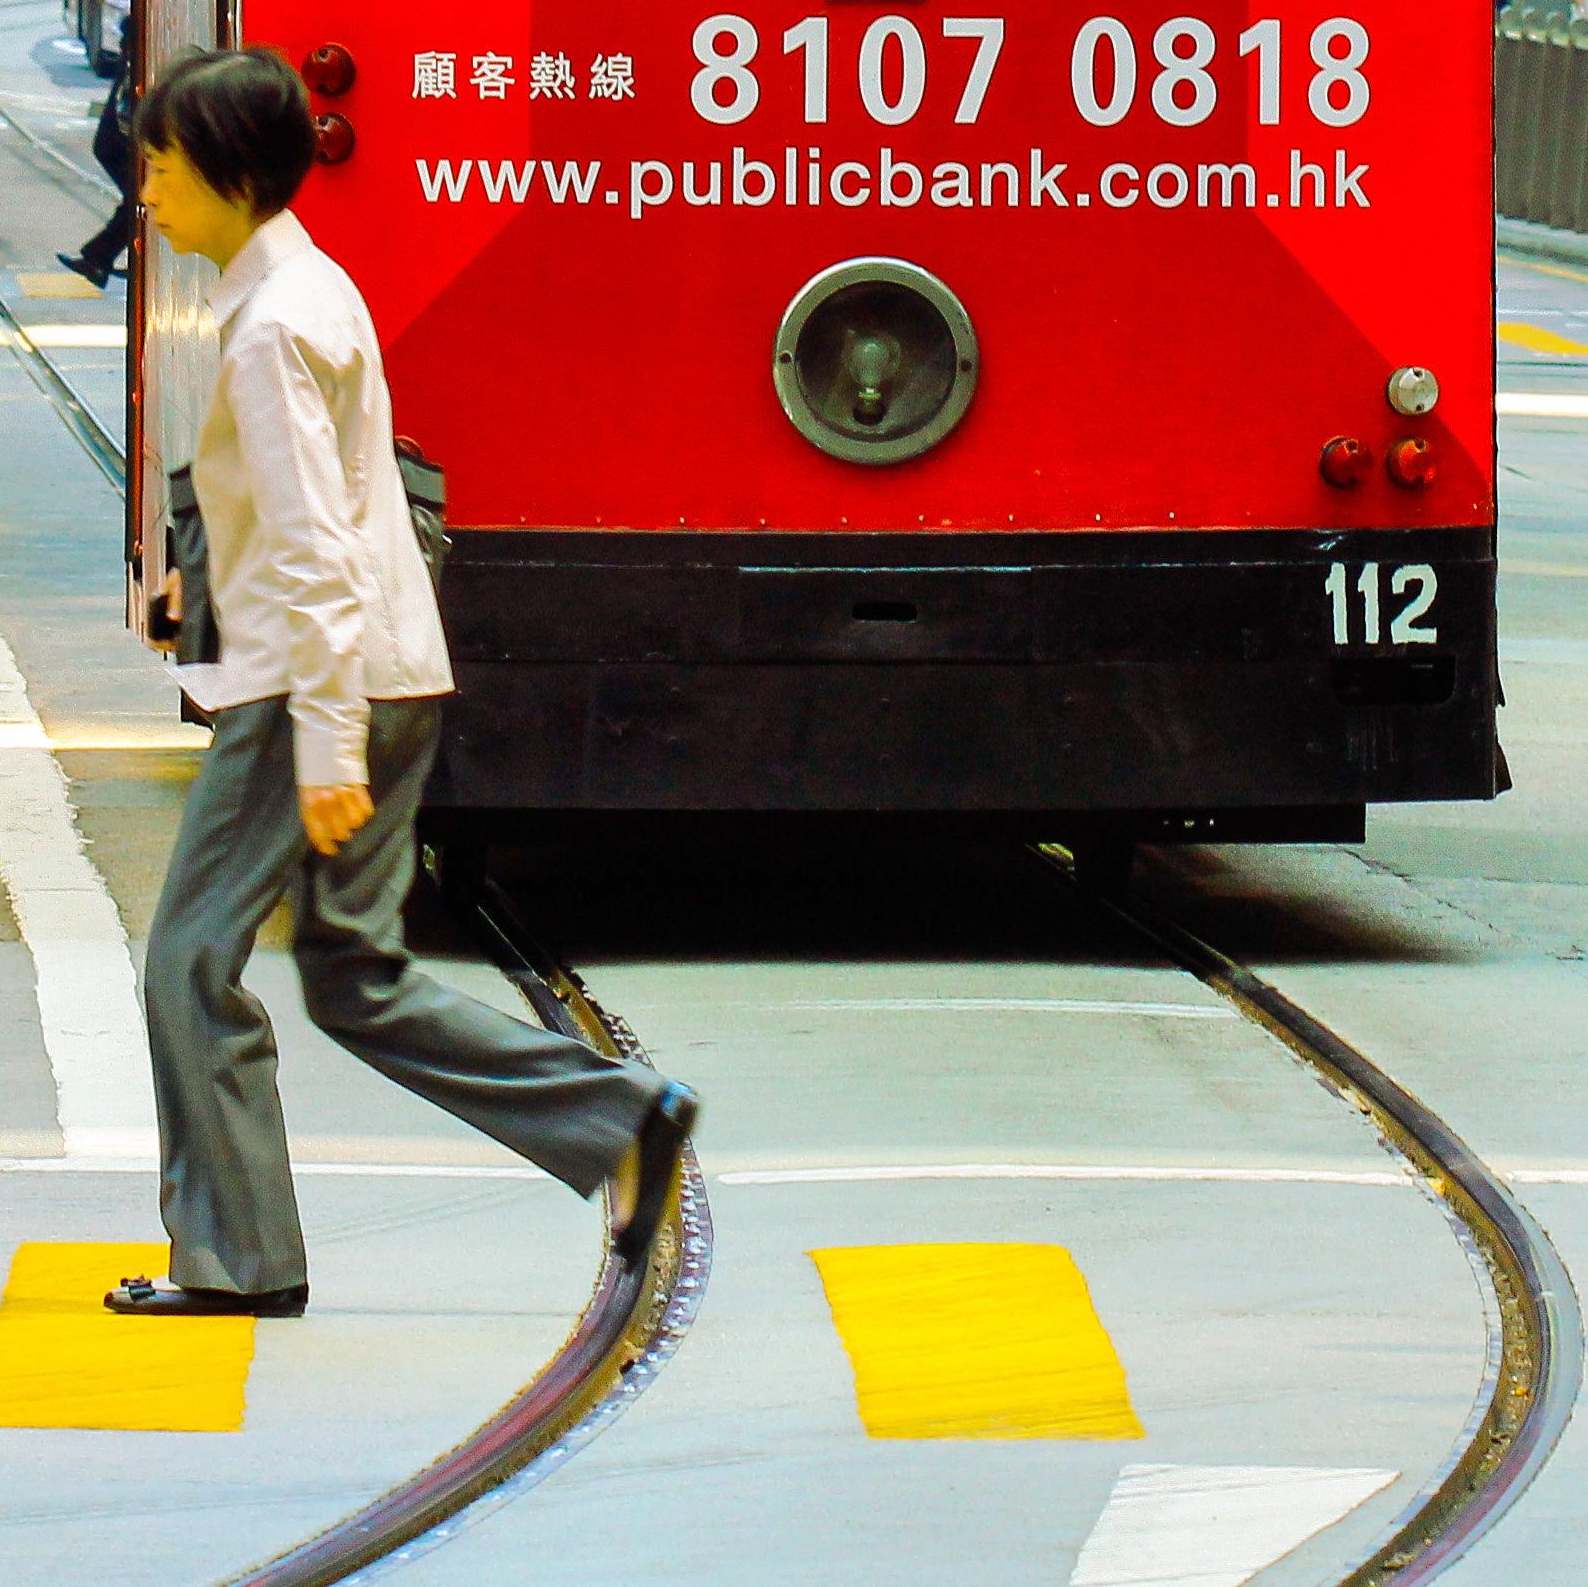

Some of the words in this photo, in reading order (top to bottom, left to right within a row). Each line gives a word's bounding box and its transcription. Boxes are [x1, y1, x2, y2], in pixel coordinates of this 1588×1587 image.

[411, 50, 636, 101] 顧客熱線
[690, 14, 1005, 125] 8107
[1071, 16, 1371, 127] 0818
[415, 146, 1372, 219] www.publicbank.com.hk
[1325, 562, 1439, 645] 112
